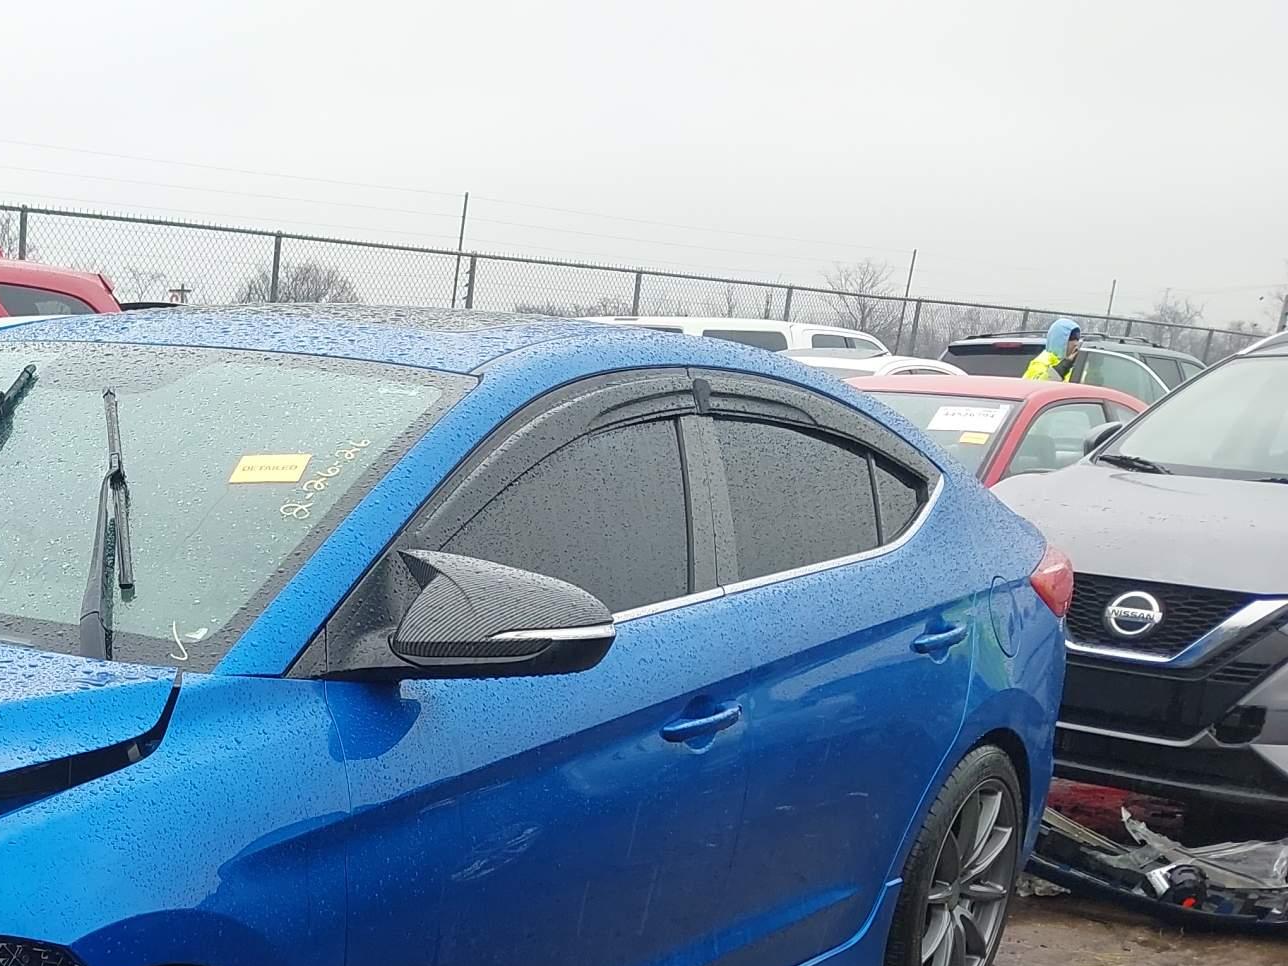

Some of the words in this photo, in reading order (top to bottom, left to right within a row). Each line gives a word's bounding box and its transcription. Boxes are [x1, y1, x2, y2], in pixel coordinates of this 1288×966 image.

[241, 463, 298, 472] DETAILED
[279, 438, 371, 520] 2-26-26
[1111, 608, 1155, 620] NISSAN
